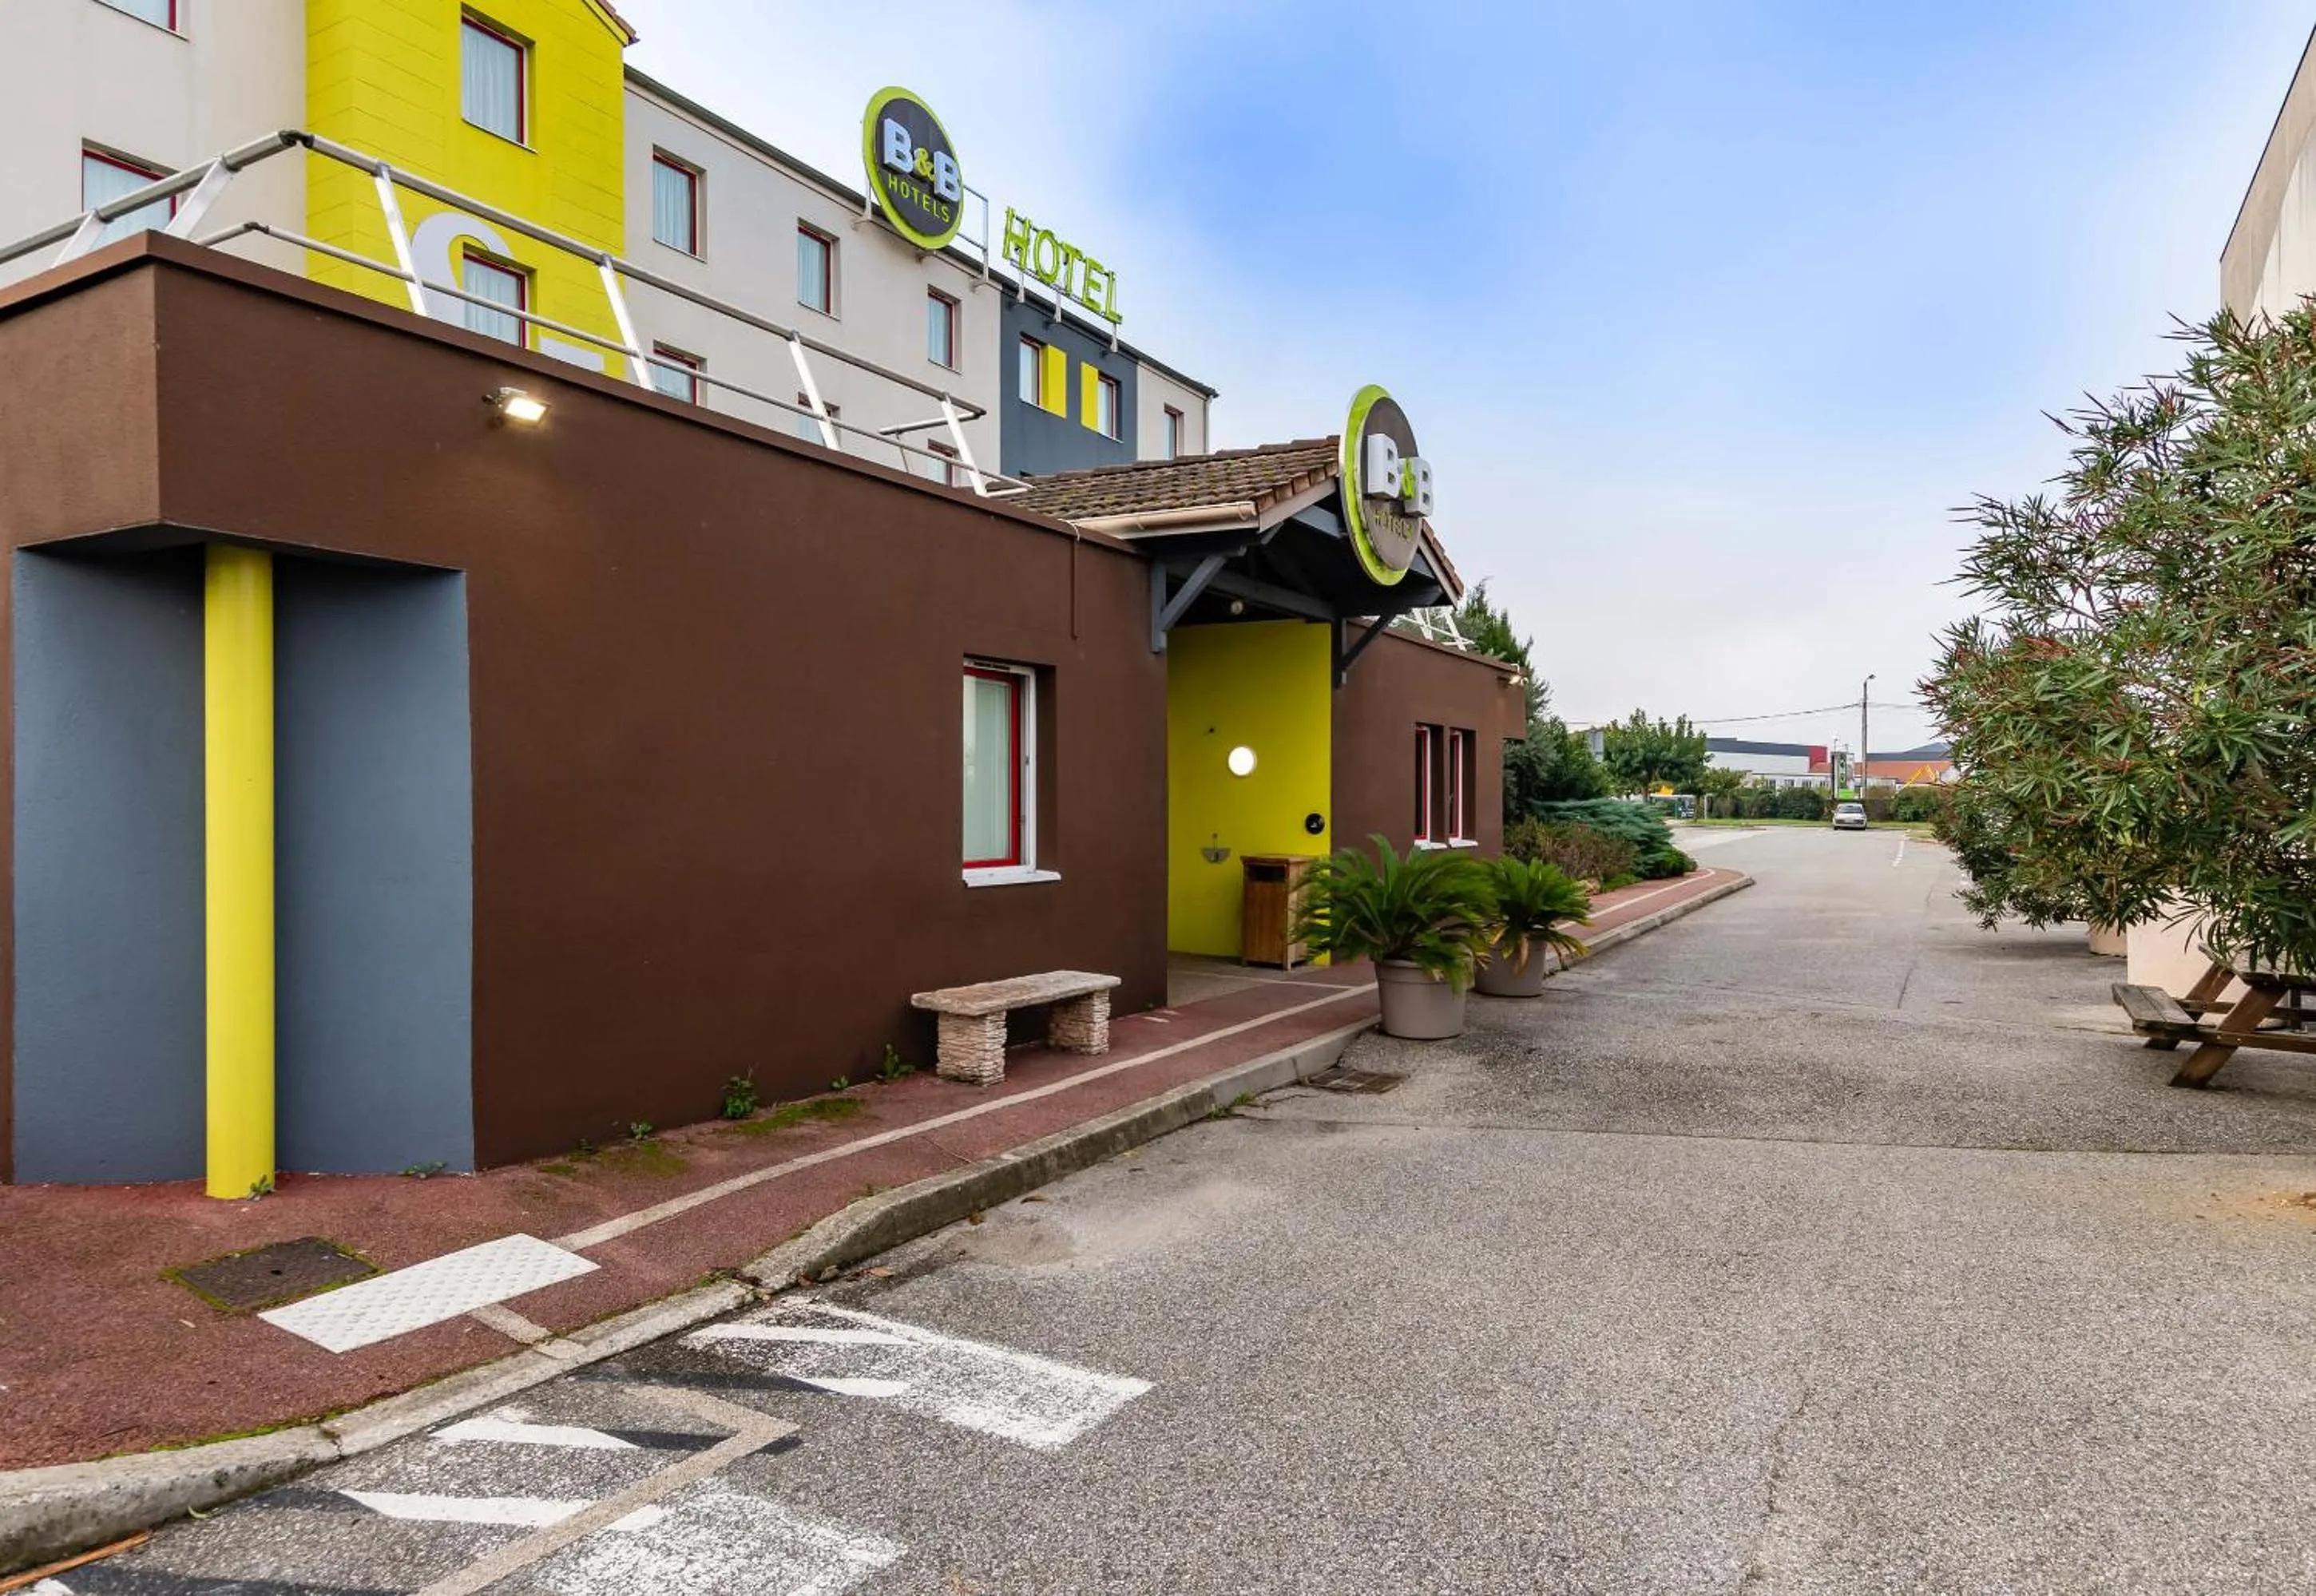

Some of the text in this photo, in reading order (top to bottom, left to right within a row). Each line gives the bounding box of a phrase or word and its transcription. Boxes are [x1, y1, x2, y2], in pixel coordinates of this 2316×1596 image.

[884, 117, 961, 201] B&B
[887, 173, 950, 224] HOTELS
[1001, 205, 1124, 325] HOTEL
[1367, 433, 1434, 517] B&B
